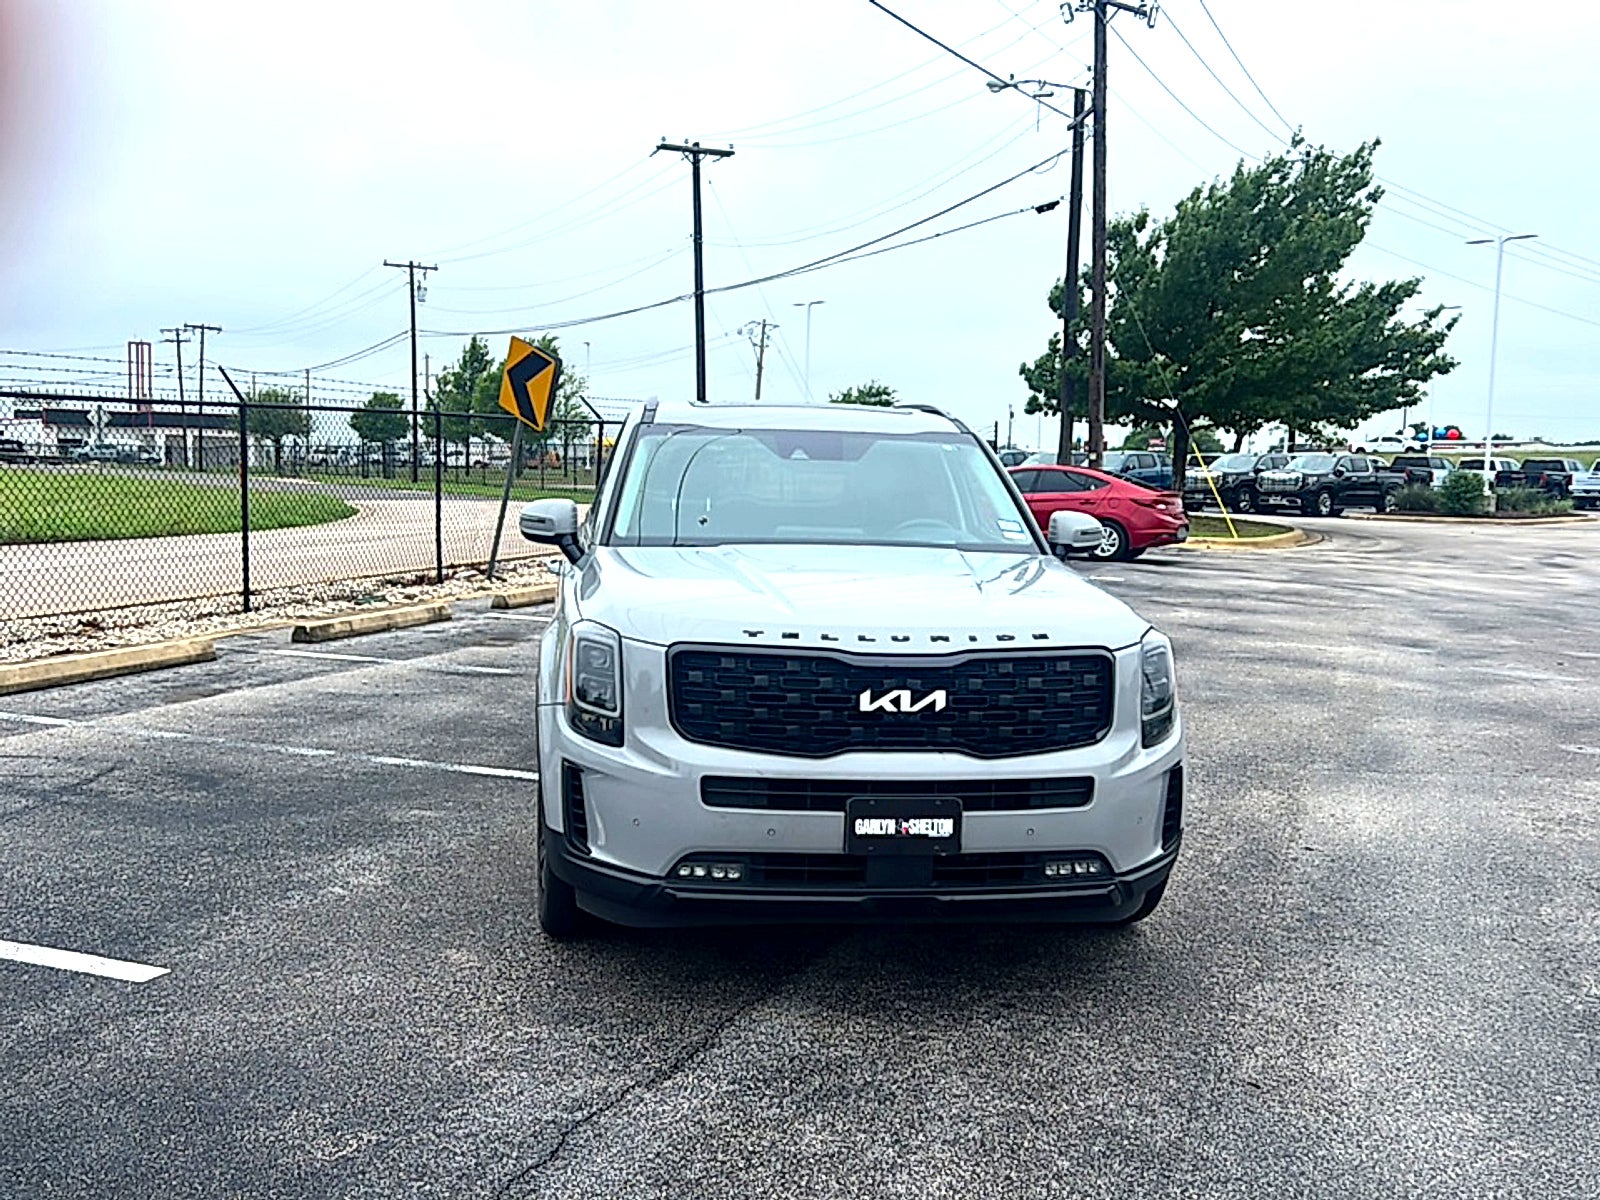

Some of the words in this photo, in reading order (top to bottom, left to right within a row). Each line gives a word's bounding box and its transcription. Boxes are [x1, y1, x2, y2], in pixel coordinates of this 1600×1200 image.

[743, 630, 1050, 642] TELLURIDE
[859, 687, 947, 712] KIA
[909, 818, 953, 835] SHELTON
